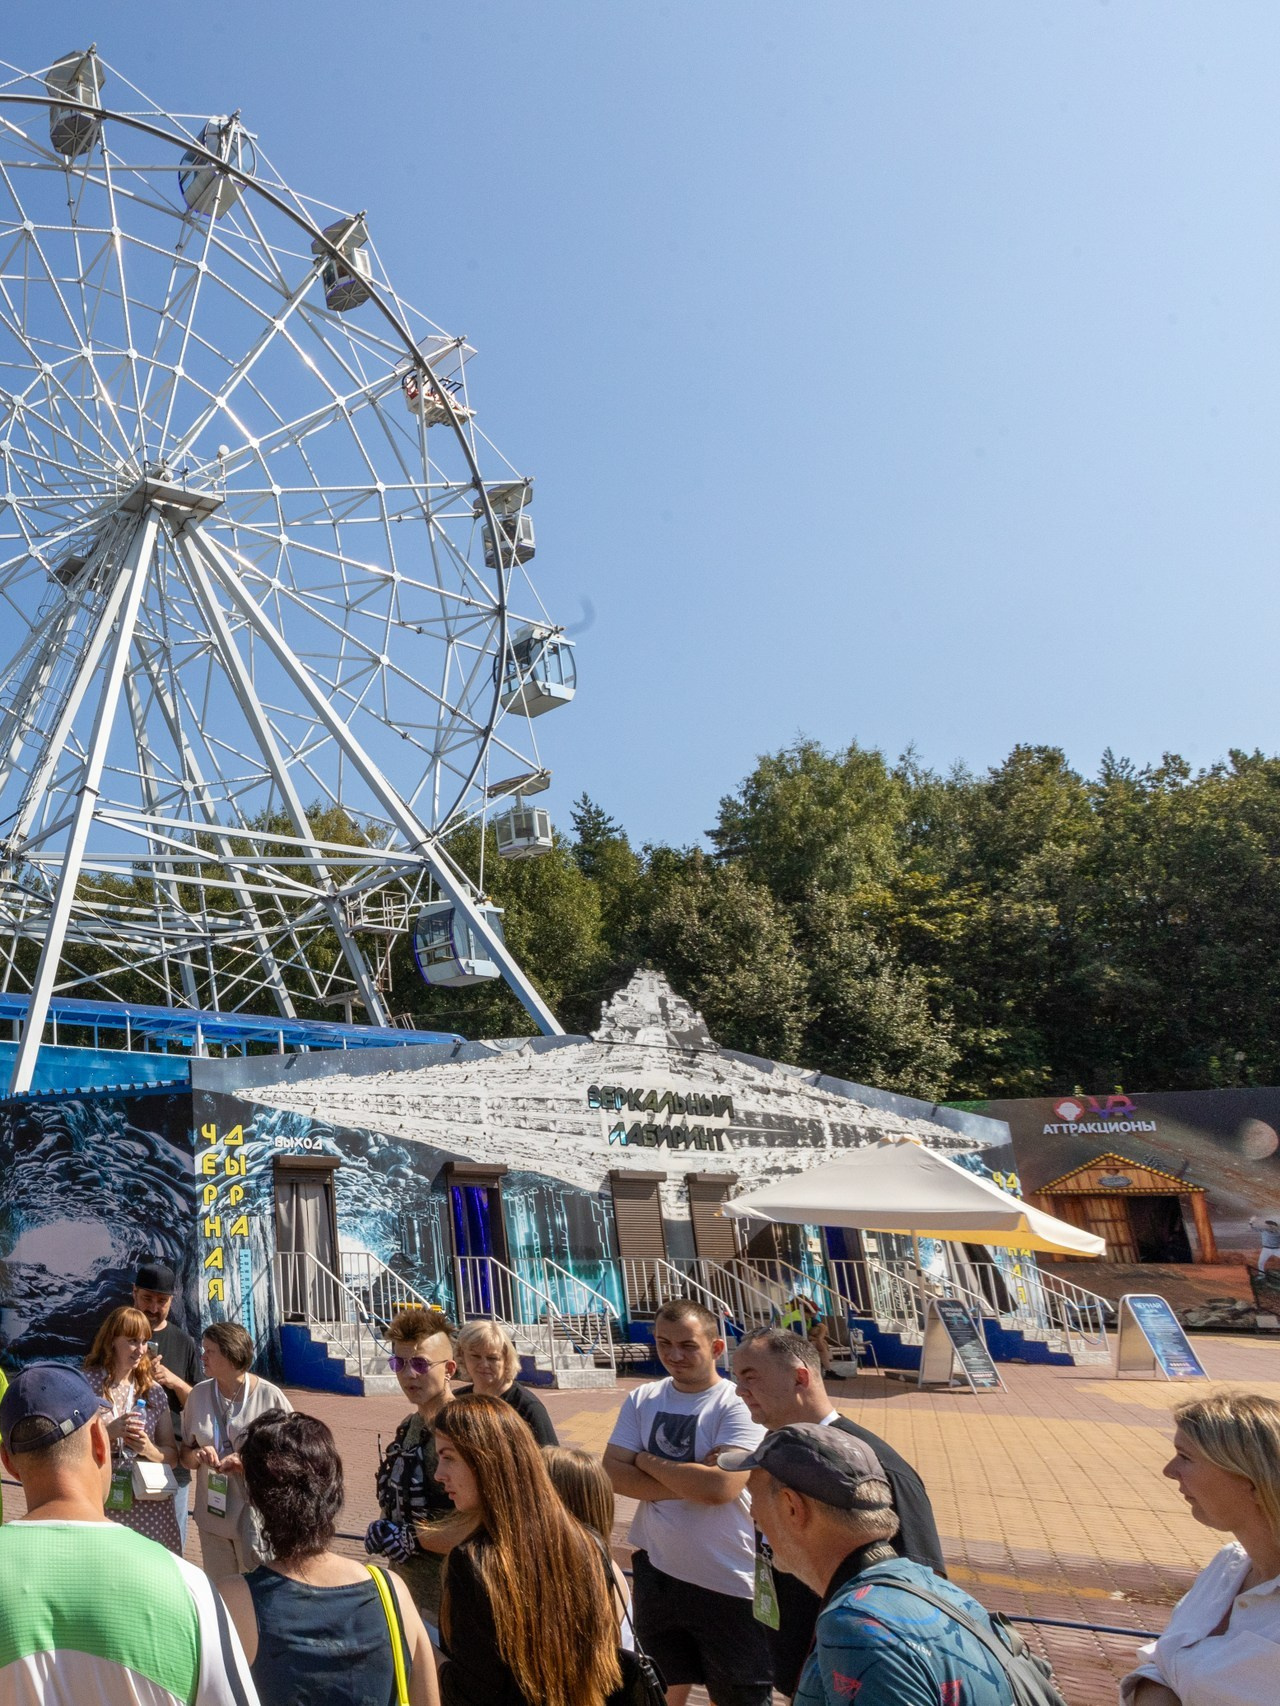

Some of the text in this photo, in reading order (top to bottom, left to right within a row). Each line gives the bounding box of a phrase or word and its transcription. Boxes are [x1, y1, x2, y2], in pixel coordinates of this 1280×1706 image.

[274, 1136, 323, 1150] ВЫХОД
[608, 1121, 726, 1152] ЛАБИРИНТ
[1043, 1120, 1157, 1135] АТТРАКЦИОНЫ
[224, 1124, 249, 1237] ДЫРА
[201, 1123, 225, 1301] ЧЕРНАЯ
